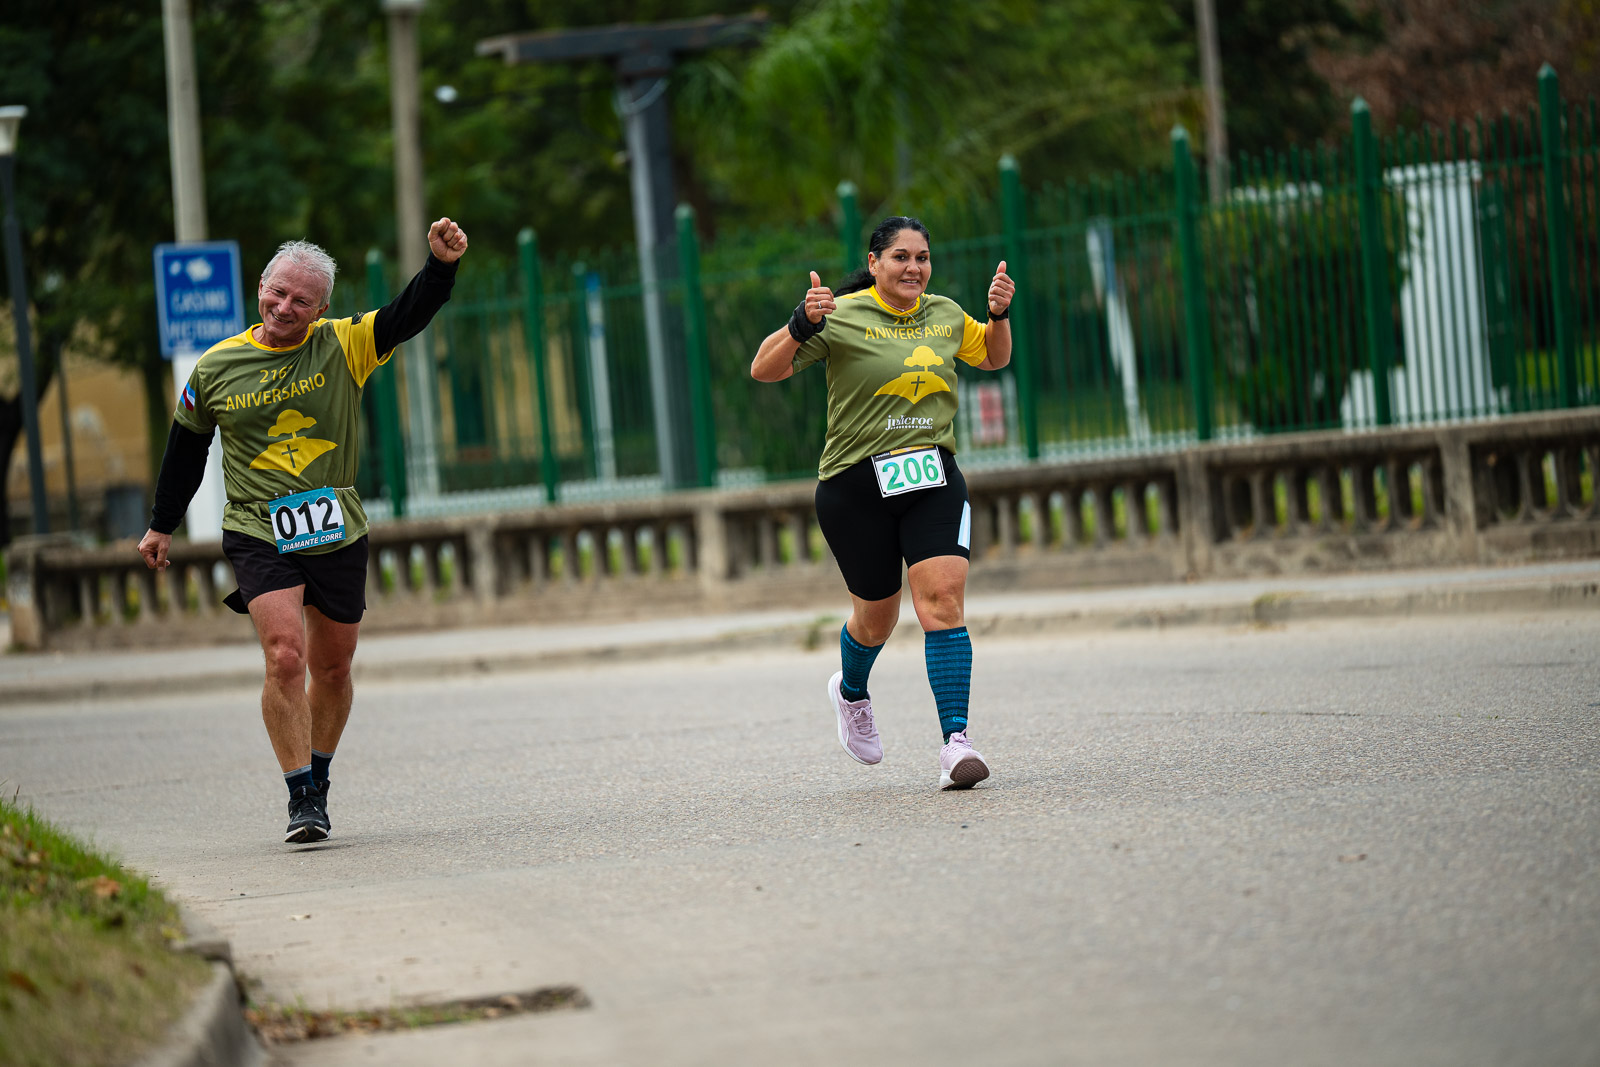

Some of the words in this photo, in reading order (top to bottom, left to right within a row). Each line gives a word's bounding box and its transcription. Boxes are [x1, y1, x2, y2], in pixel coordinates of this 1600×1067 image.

[864, 324, 953, 340] ANIVERSARIO
[225, 372, 326, 411] ANIVERSARIO
[882, 454, 939, 490] 206
[275, 495, 339, 541] 012
[282, 537, 319, 552] DIAMANTE
[320, 531, 343, 542] CORRE
